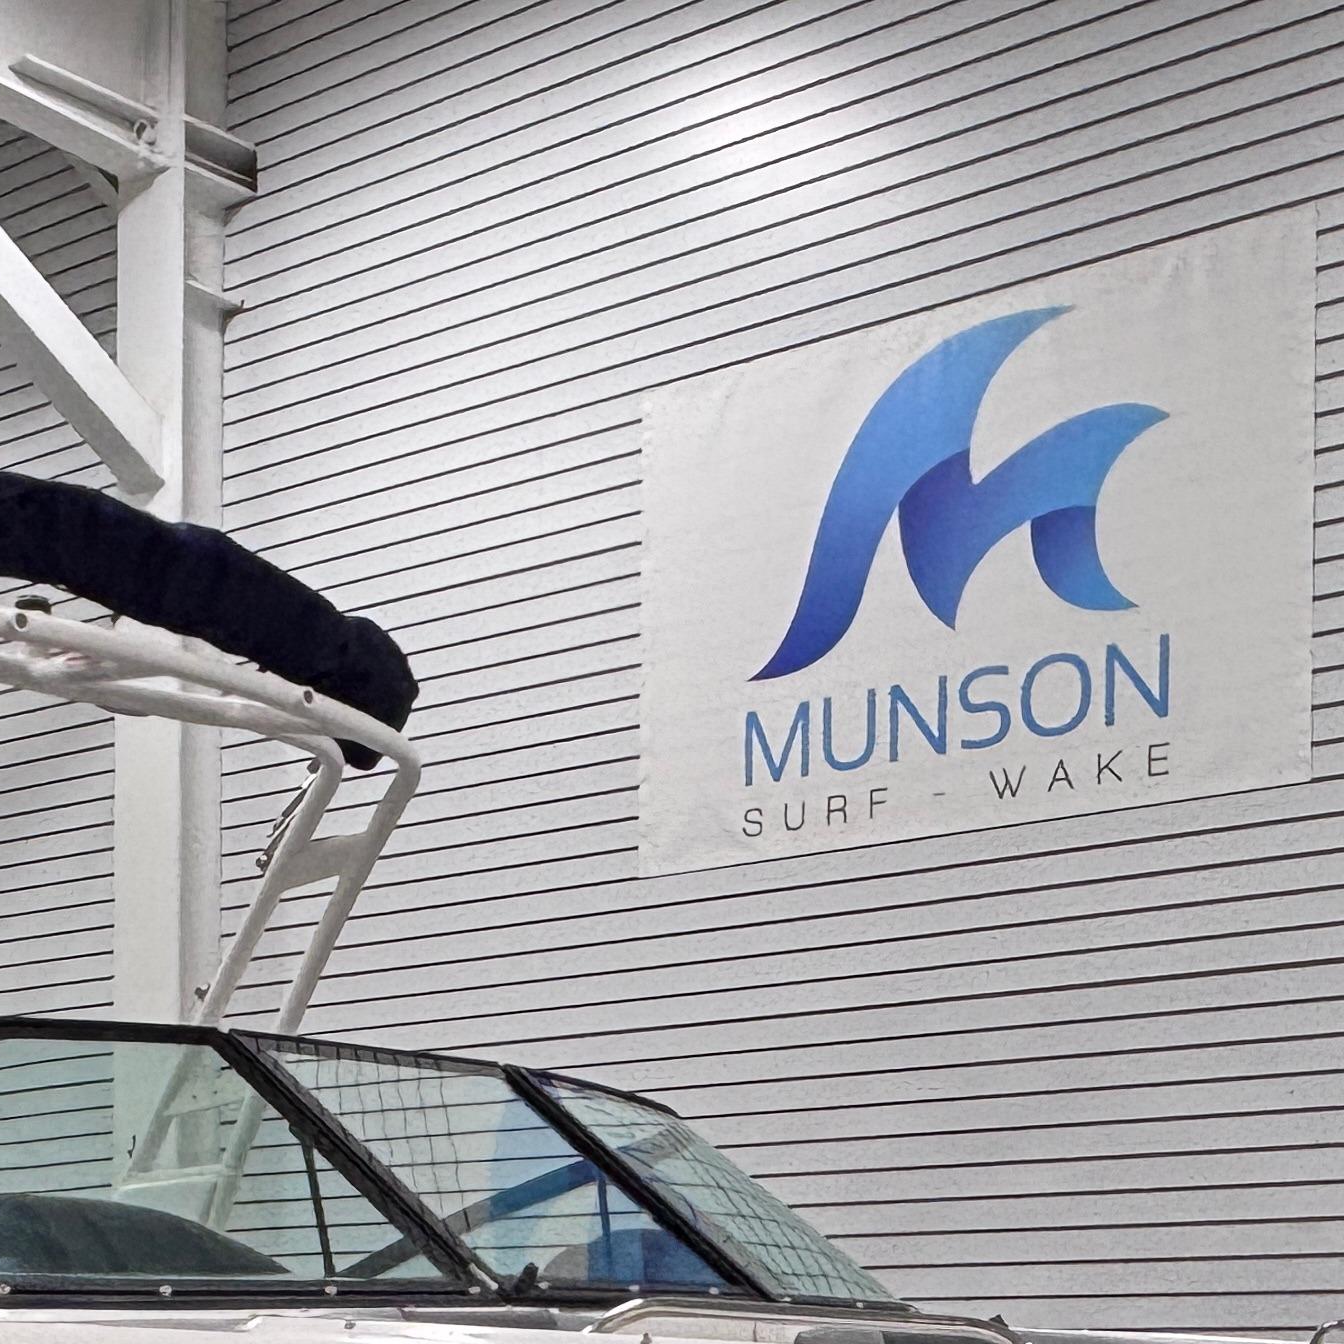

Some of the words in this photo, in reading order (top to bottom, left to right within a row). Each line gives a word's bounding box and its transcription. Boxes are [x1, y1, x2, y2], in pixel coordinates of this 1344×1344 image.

[744, 633, 1171, 787] MUNSON
[742, 787, 888, 838] SURF
[988, 742, 1171, 800] WAKE
